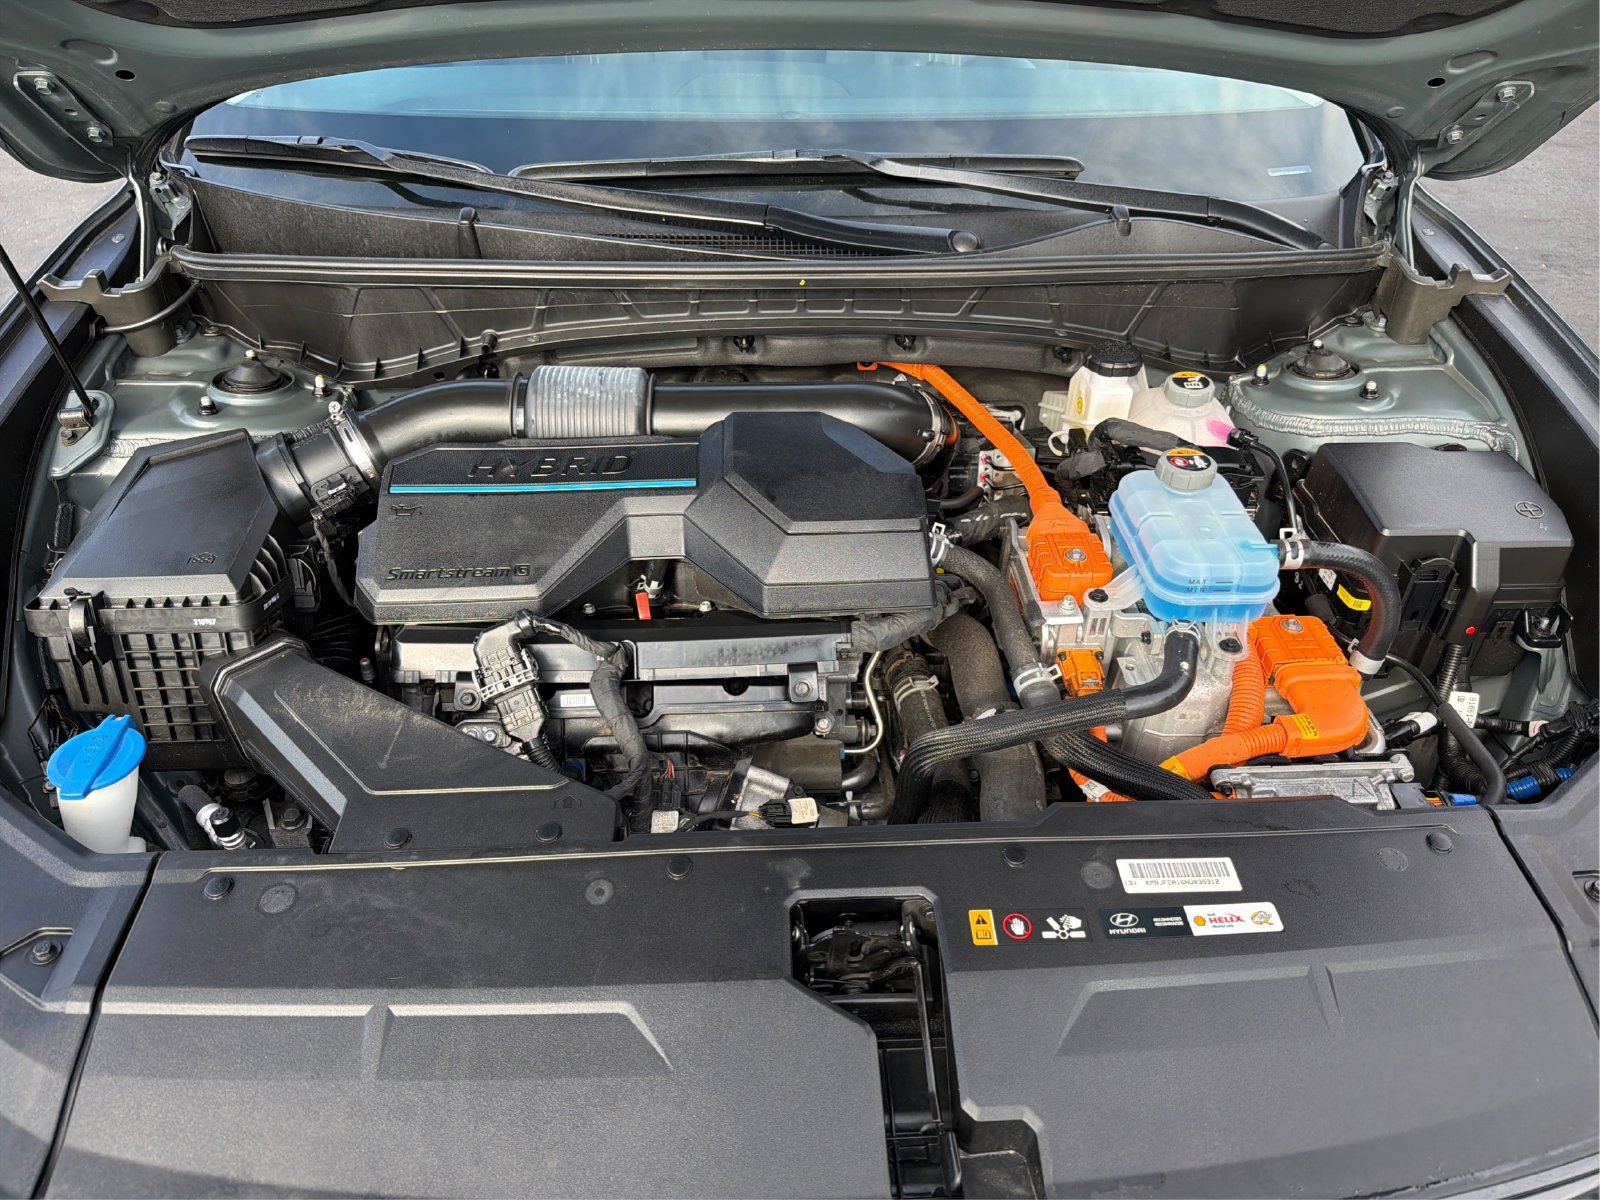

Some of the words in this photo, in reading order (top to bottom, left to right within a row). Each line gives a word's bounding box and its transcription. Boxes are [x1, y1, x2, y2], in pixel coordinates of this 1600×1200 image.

[467, 455, 632, 478] HYBRID
[385, 566, 511, 581] Smartstream
[1208, 915, 1245, 924] HELIX
[1109, 927, 1147, 935] HYUNDAI
